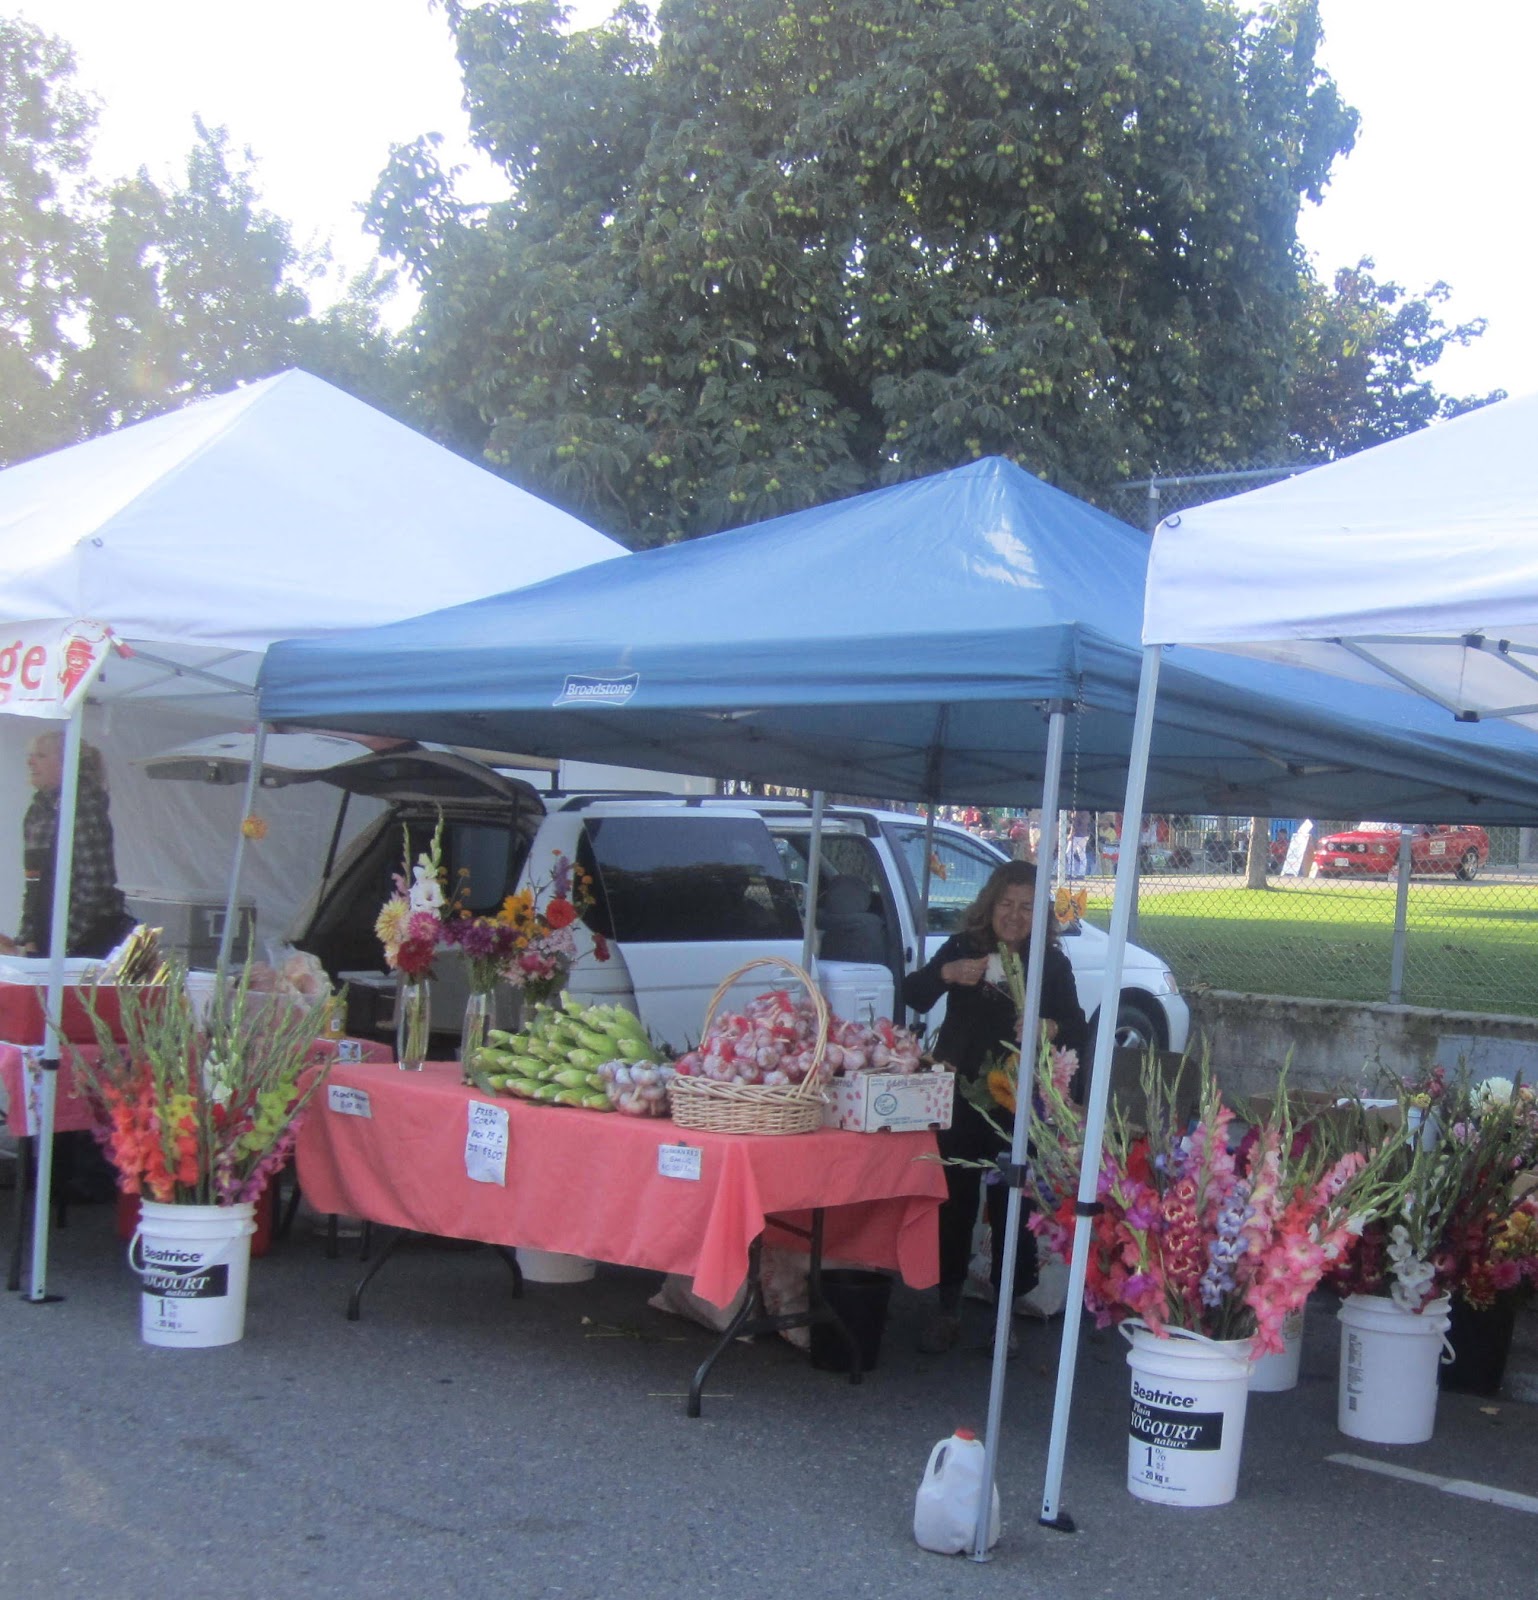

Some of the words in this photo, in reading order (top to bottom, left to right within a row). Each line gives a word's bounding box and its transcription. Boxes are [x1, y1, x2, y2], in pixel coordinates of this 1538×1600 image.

[566, 683, 632, 696] Broadstone
[474, 1117, 496, 1125] CORN
[1133, 1381, 1194, 1408] Beatrice
[1131, 1411, 1202, 1440] YOGOURT
[1153, 1437, 1188, 1449] nature
